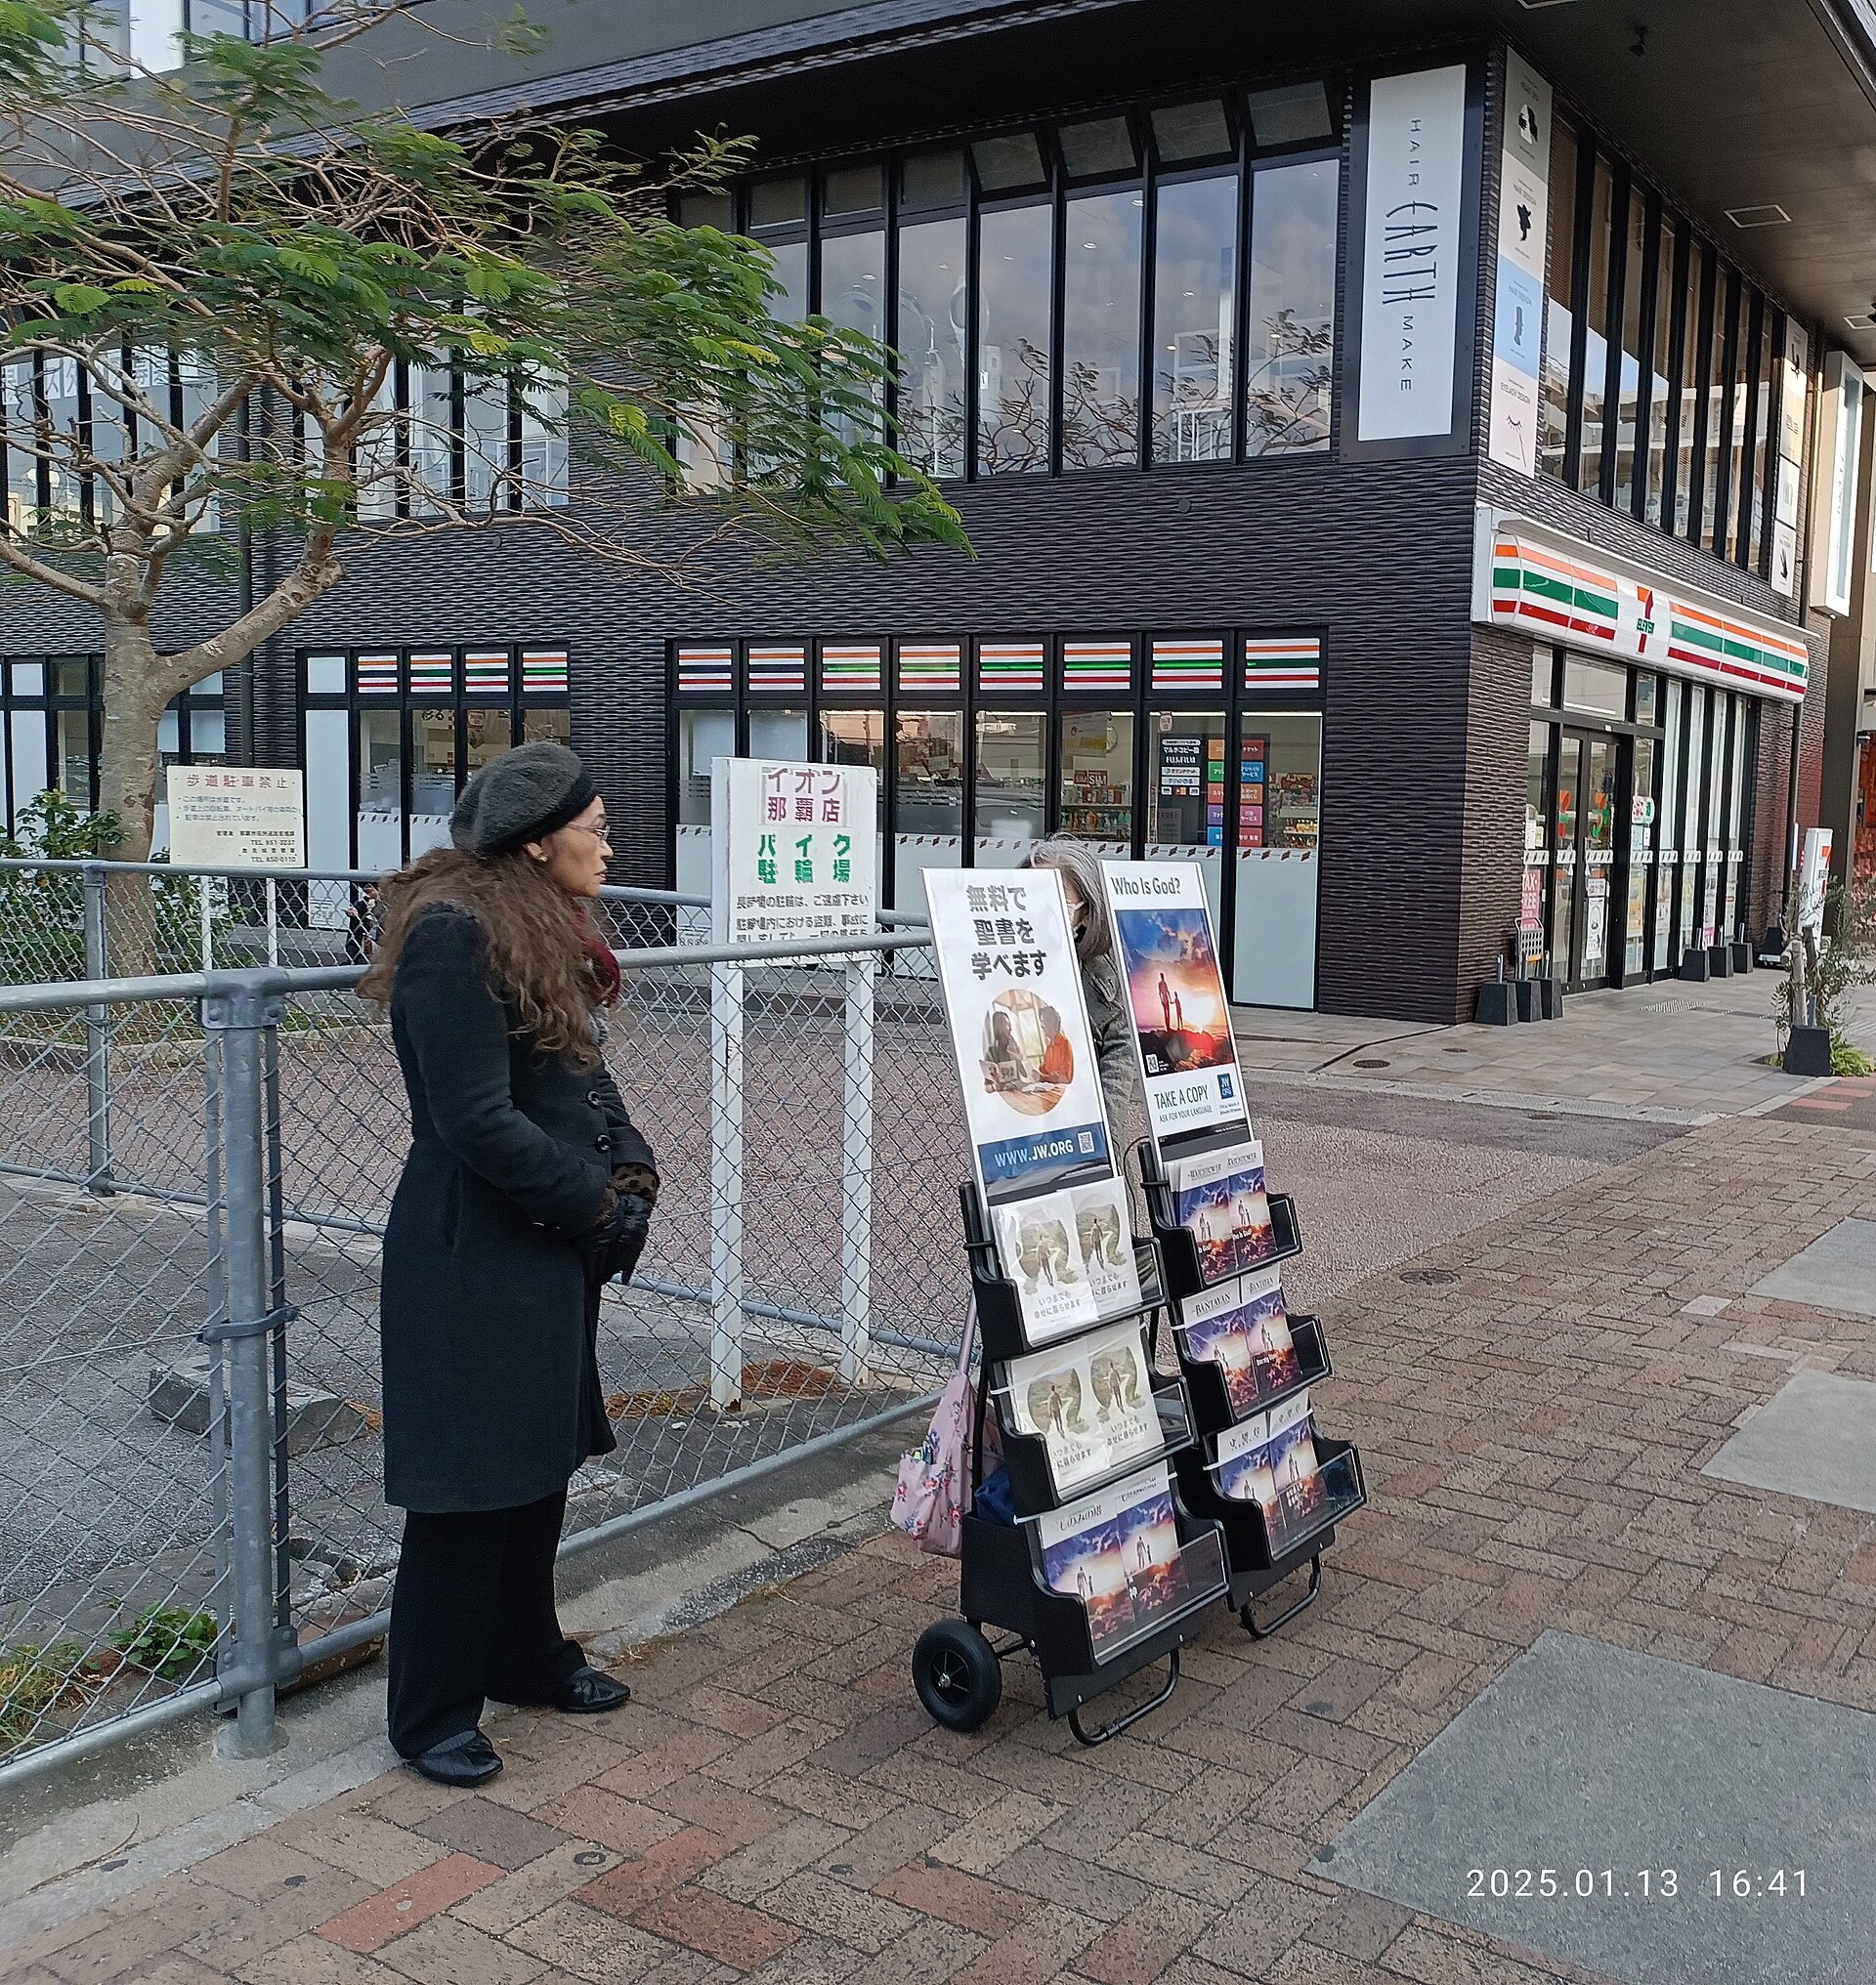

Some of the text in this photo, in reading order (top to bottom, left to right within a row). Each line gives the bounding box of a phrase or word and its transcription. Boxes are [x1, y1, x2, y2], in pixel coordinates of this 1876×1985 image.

[1408, 118, 1422, 187] HAIR
[1382, 199, 1438, 305] EARTH
[1400, 316, 1414, 391] MAKE
[187, 775, 288, 788] 歩道駐車禁止
[767, 768, 840, 795] イオン
[767, 796, 840, 823] 那覇店
[757, 834, 851, 858] バイク
[757, 859, 851, 884] 駐輪場
[966, 885, 1026, 911] 無料で
[1110, 877, 1180, 895] Who Is God?
[973, 918, 1035, 946] 聖書を
[971, 950, 1046, 980] 学べます
[1154, 1084, 1209, 1110] TAKE A COPY
[995, 1139, 1074, 1167] WWW.JW.ORG
[1039, 1290, 1071, 1306] いつまでも
